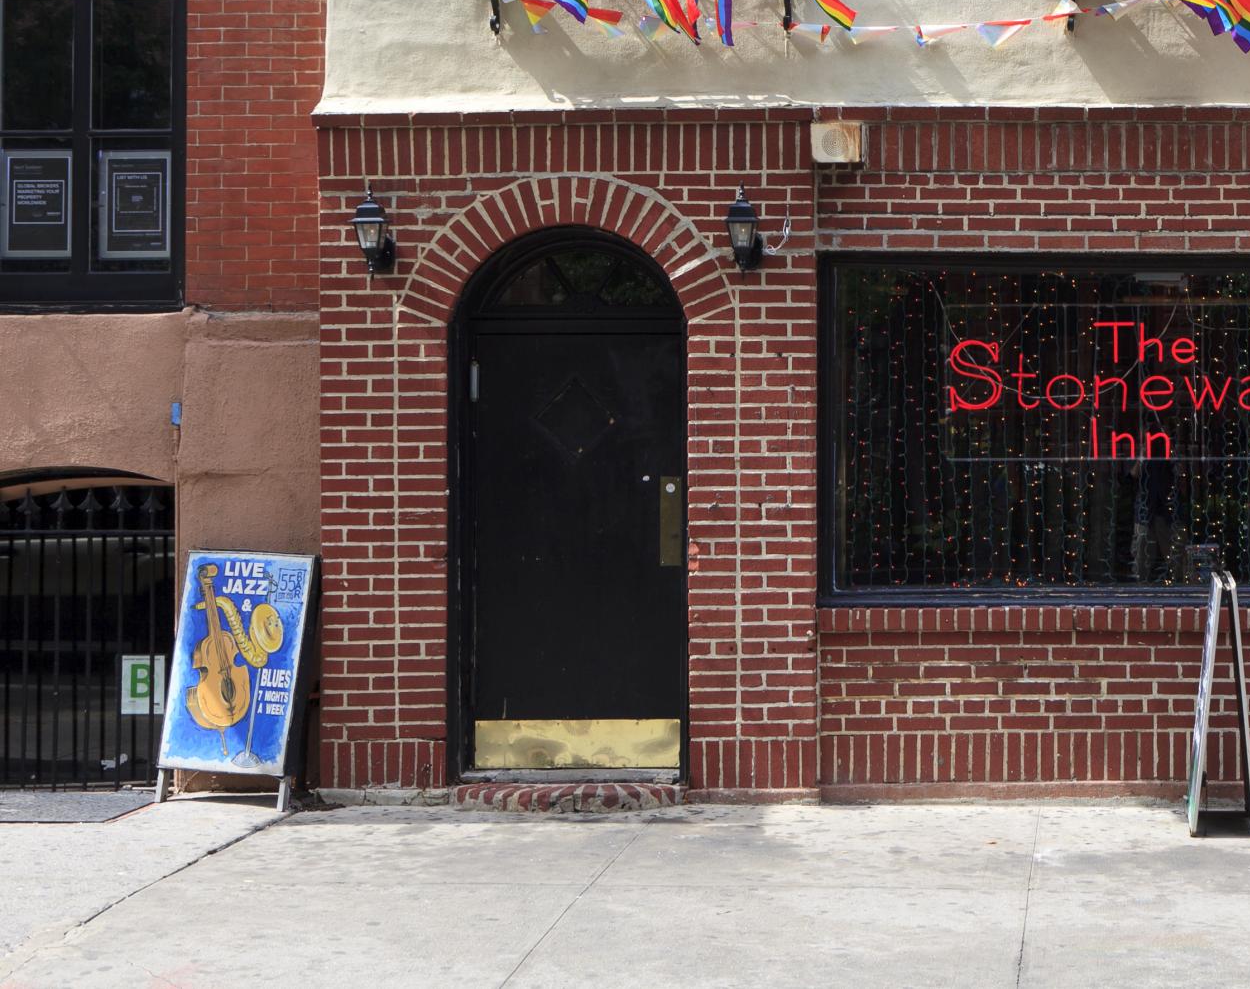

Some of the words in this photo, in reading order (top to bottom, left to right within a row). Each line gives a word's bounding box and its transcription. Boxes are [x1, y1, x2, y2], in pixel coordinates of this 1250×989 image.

[1093, 321, 1197, 364] The
[1091, 416, 1171, 461] Inn
[224, 561, 265, 578] LIVE
[222, 578, 270, 596] JAZZ
[280, 573, 296, 592] 55
[294, 571, 302, 599] BAR
[241, 598, 253, 612] &
[130, 663, 152, 698] B
[260, 668, 292, 689] BLUES
[258, 690, 264, 701] 7
[264, 690, 289, 703] NIGHTS
[257, 702, 263, 714] A
[265, 703, 286, 716] WEEK
